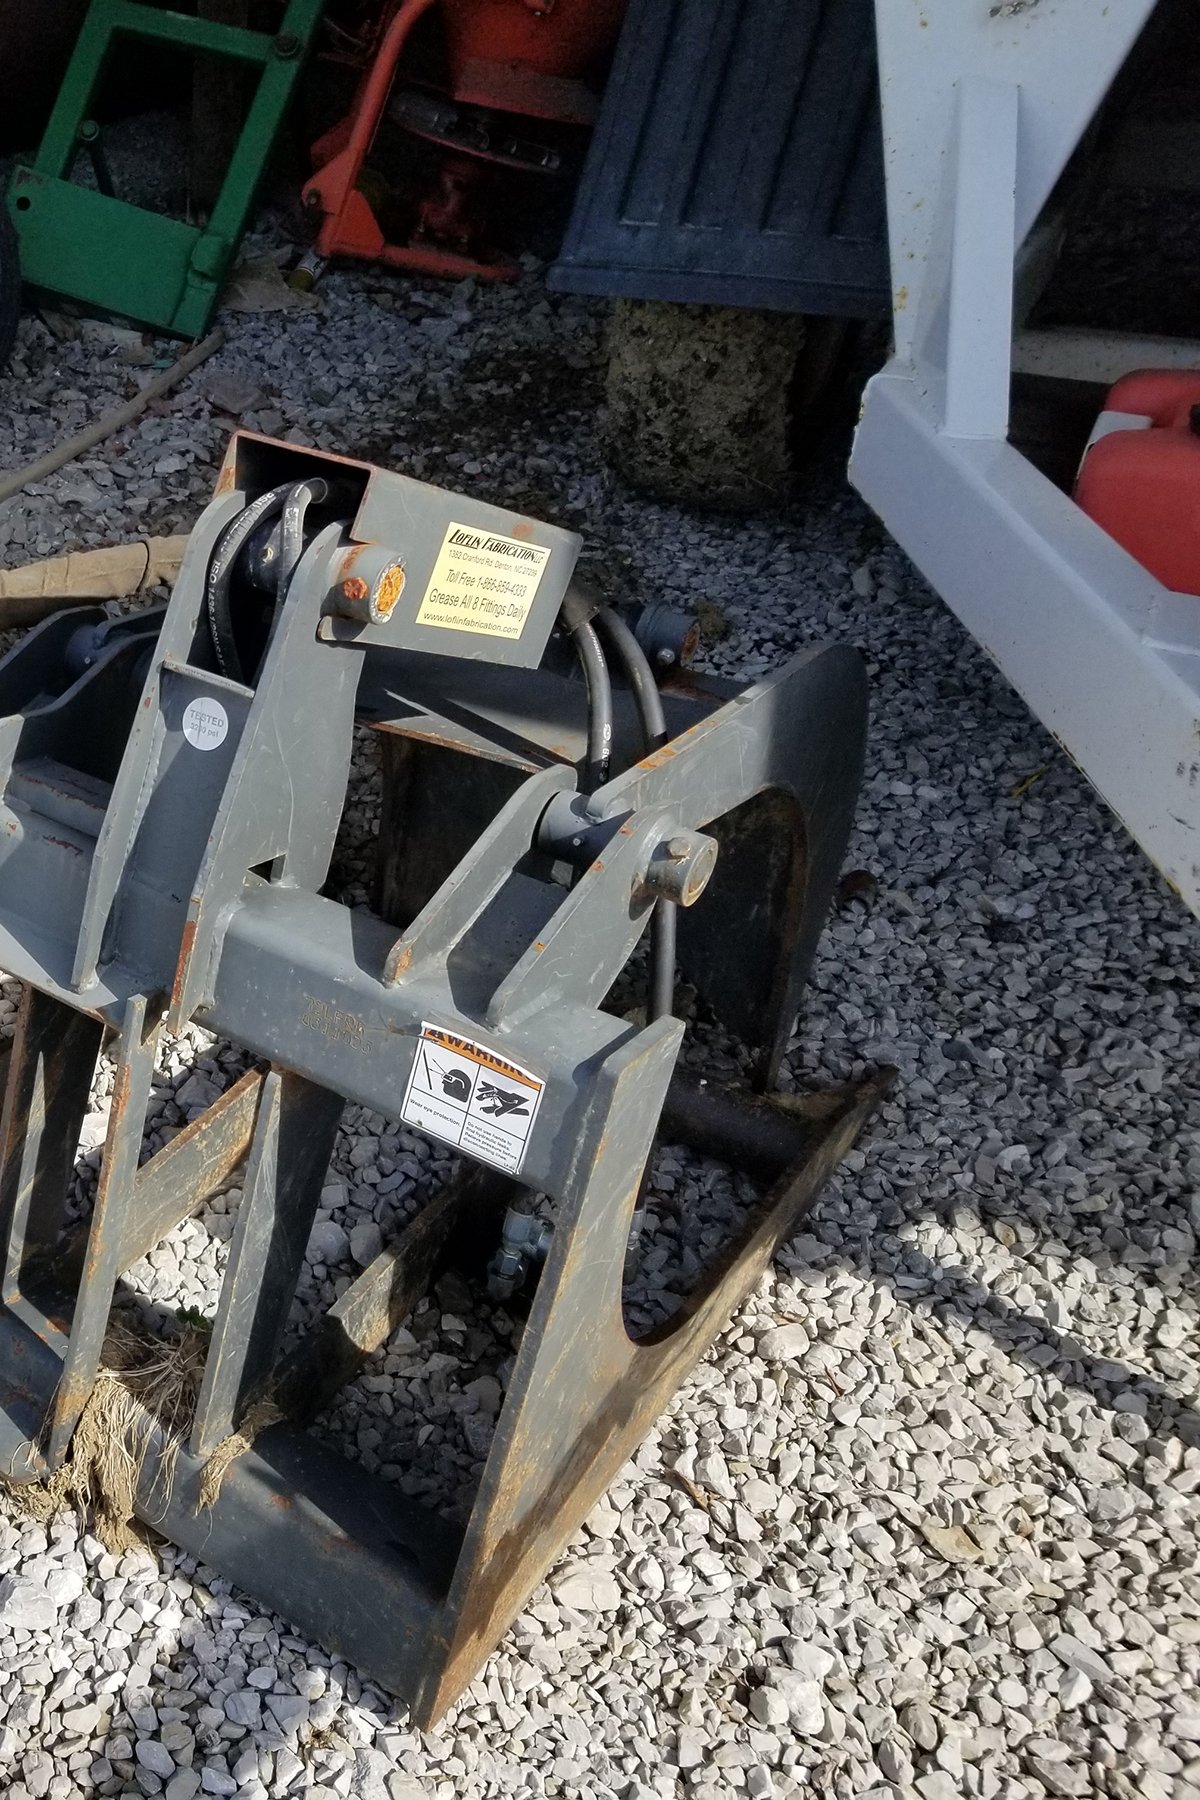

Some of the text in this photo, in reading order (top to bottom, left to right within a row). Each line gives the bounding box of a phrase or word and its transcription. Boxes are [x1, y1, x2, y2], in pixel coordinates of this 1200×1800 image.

[448, 529, 484, 550] LOFLIN
[481, 537, 540, 562] FABRICATION
[446, 568, 461, 583] Toll
[458, 572, 476, 587] Free
[429, 588, 527, 622] Grease All 8 Fittings Daily
[190, 709, 224, 727] TESTED
[445, 1032, 531, 1081] WARNIN
